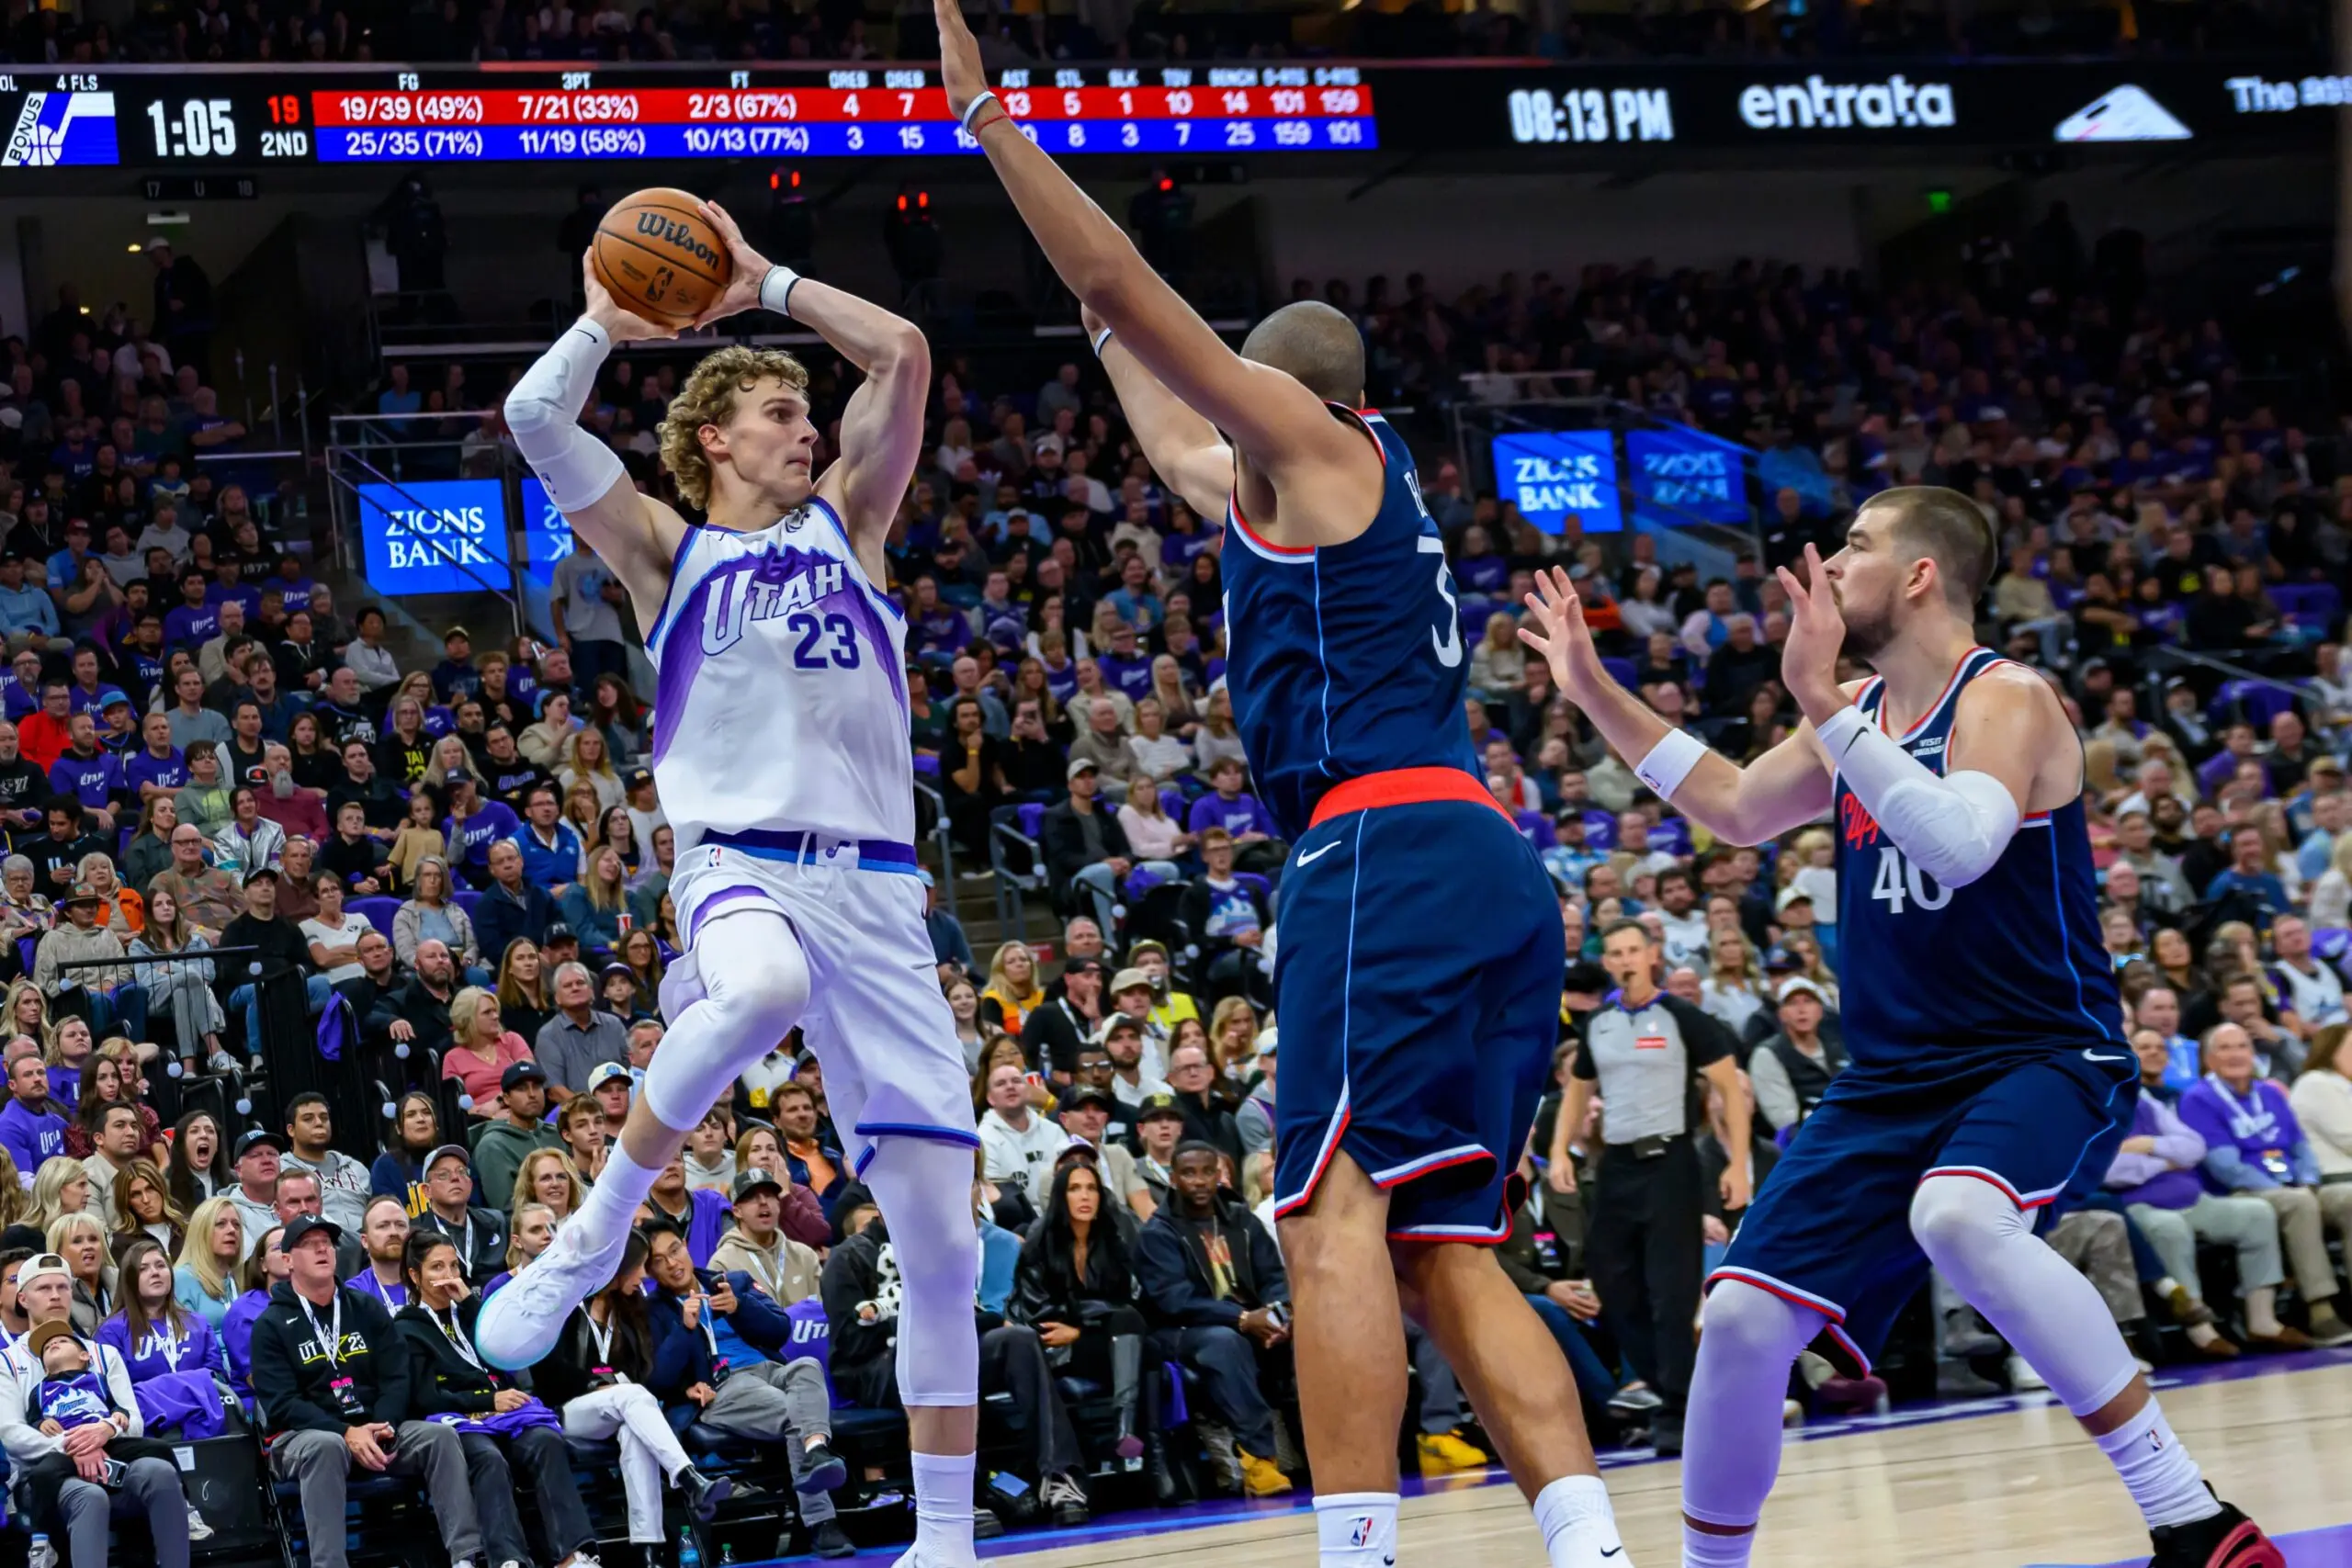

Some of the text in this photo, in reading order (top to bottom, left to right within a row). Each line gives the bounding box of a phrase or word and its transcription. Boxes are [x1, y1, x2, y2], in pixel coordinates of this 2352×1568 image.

[56, 74, 98, 91] 4 FLS
[399, 74, 419, 90] FG
[562, 73, 591, 90] 3PT
[731, 71, 749, 88] FT
[2223, 75, 2297, 112] The
[267, 96, 300, 123] 19
[339, 96, 411, 121] 19/39
[416, 96, 482, 122] (49%)
[517, 96, 569, 119] 7/21
[573, 95, 638, 121] (33%)
[688, 96, 731, 118] 2/3
[735, 95, 797, 120] (67%)
[842, 93, 860, 117] 4
[898, 93, 914, 117] 7
[1005, 92, 1032, 116] 13
[1064, 91, 1081, 116] 5
[1118, 90, 1133, 115] 1
[1165, 90, 1193, 115] 10
[1221, 90, 1250, 114] 14
[1270, 90, 1306, 113] 101
[1509, 88, 1673, 141] 08:13 PM
[1738, 74, 1955, 129] entrata
[8, 97, 41, 161] BONUS
[147, 99, 236, 156] 1:05
[261, 131, 308, 156] 2ND
[346, 130, 419, 155] 25/35
[424, 129, 482, 156] (71%)
[518, 130, 575, 153] 11/19
[581, 128, 645, 155] (58%)
[684, 129, 745, 152] 10/13
[750, 127, 809, 153] (77%)
[846, 126, 865, 150] 3
[899, 125, 924, 150] 15
[1068, 123, 1085, 147] 8
[1121, 123, 1139, 147] 3
[1174, 122, 1193, 146] 7
[1225, 121, 1256, 146] 25
[1327, 120, 1363, 144] 101
[638, 212, 719, 272] Wilson
[1518, 481, 1604, 512] BANK
[385, 507, 485, 536] ZIONS
[701, 560, 844, 656] UTAH
[787, 614, 860, 670] 23
[1872, 846, 1954, 914] 40
[348, 1335, 367, 1352] 23
[793, 1319, 830, 1344] UTA
